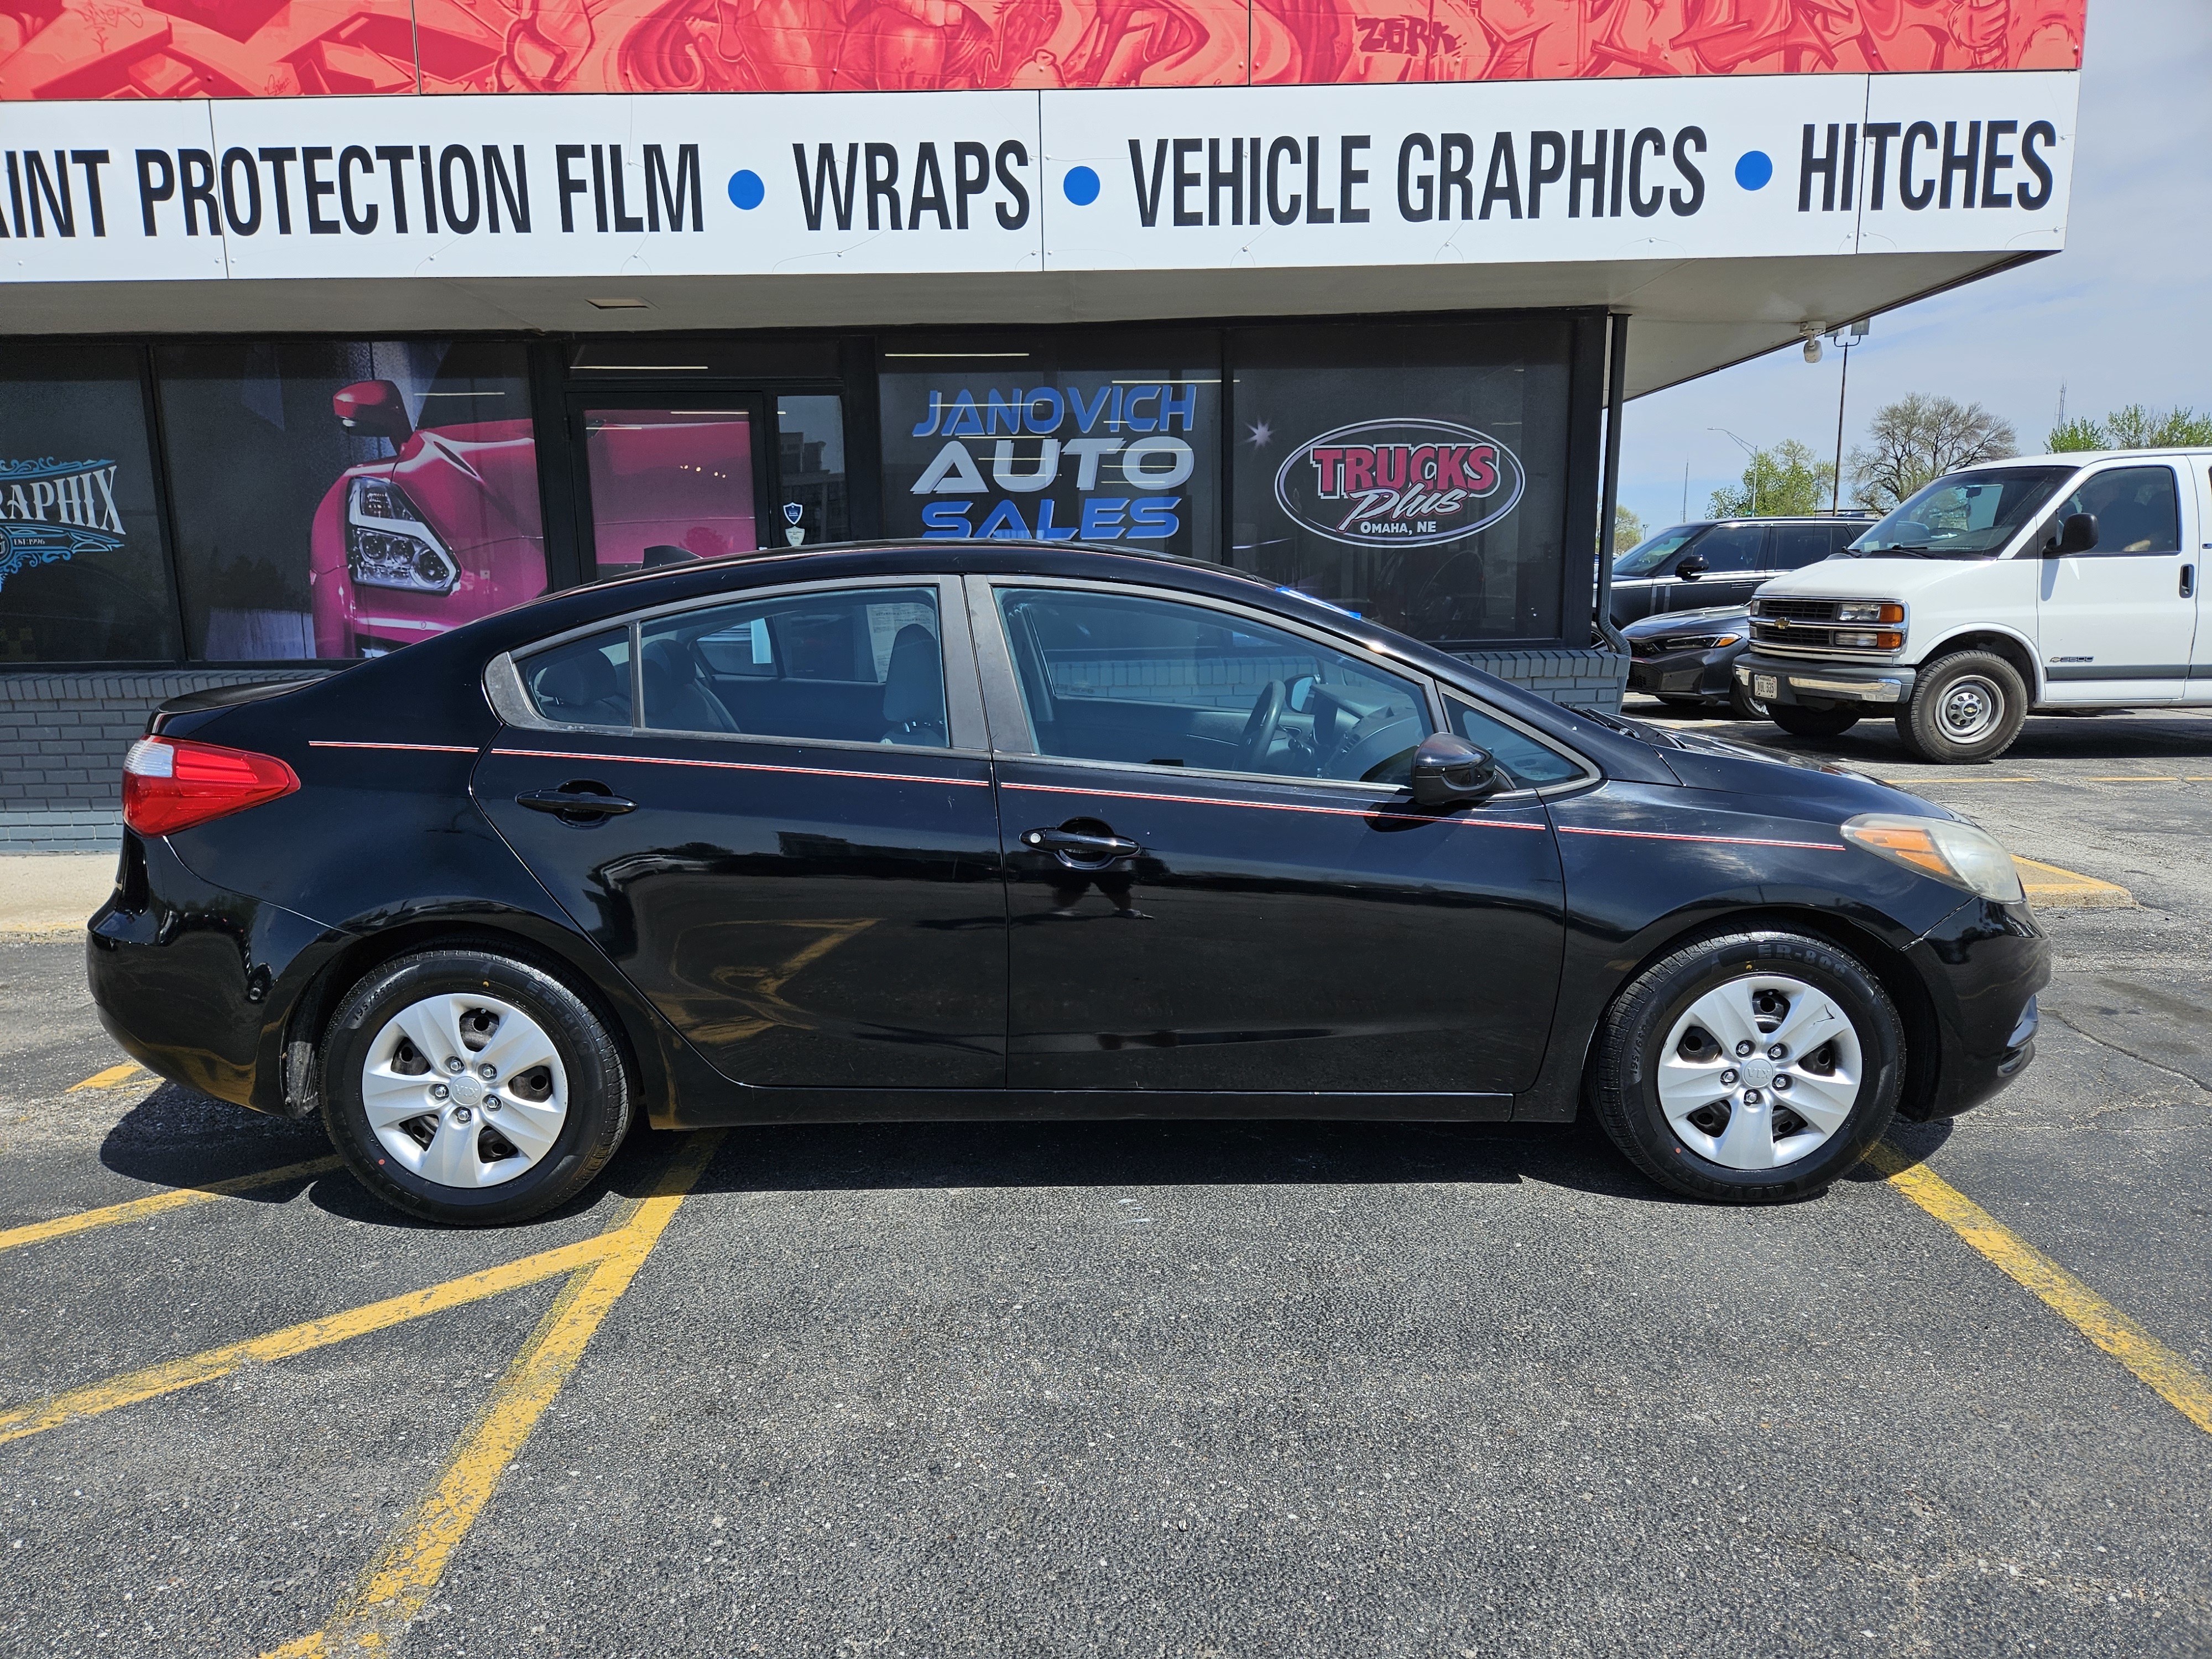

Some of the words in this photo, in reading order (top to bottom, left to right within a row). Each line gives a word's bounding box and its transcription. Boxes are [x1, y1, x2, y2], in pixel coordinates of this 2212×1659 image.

[0, 150, 110, 238] INT
[135, 145, 532, 237] PROTECTION
[555, 144, 704, 233] FILM
[792, 140, 1030, 231] WRAPS
[1128, 136, 1371, 227] VEHICLE
[1397, 126, 1707, 223] GRAPHICS
[1798, 120, 2056, 212] HITCHES
[912, 385, 1197, 437] JANOVICH
[910, 436, 1194, 494] AUTO
[1311, 444, 1499, 498] TRUCKS
[922, 497, 1182, 540] SALES
[1338, 481, 1468, 531] Plus
[1360, 520, 1412, 535] OMAHA,
[1417, 520, 1436, 533] NE
[1758, 943, 1846, 978] ER-800
[455, 1084, 478, 1098] KIA
[1747, 1067, 1770, 1079] KIA
